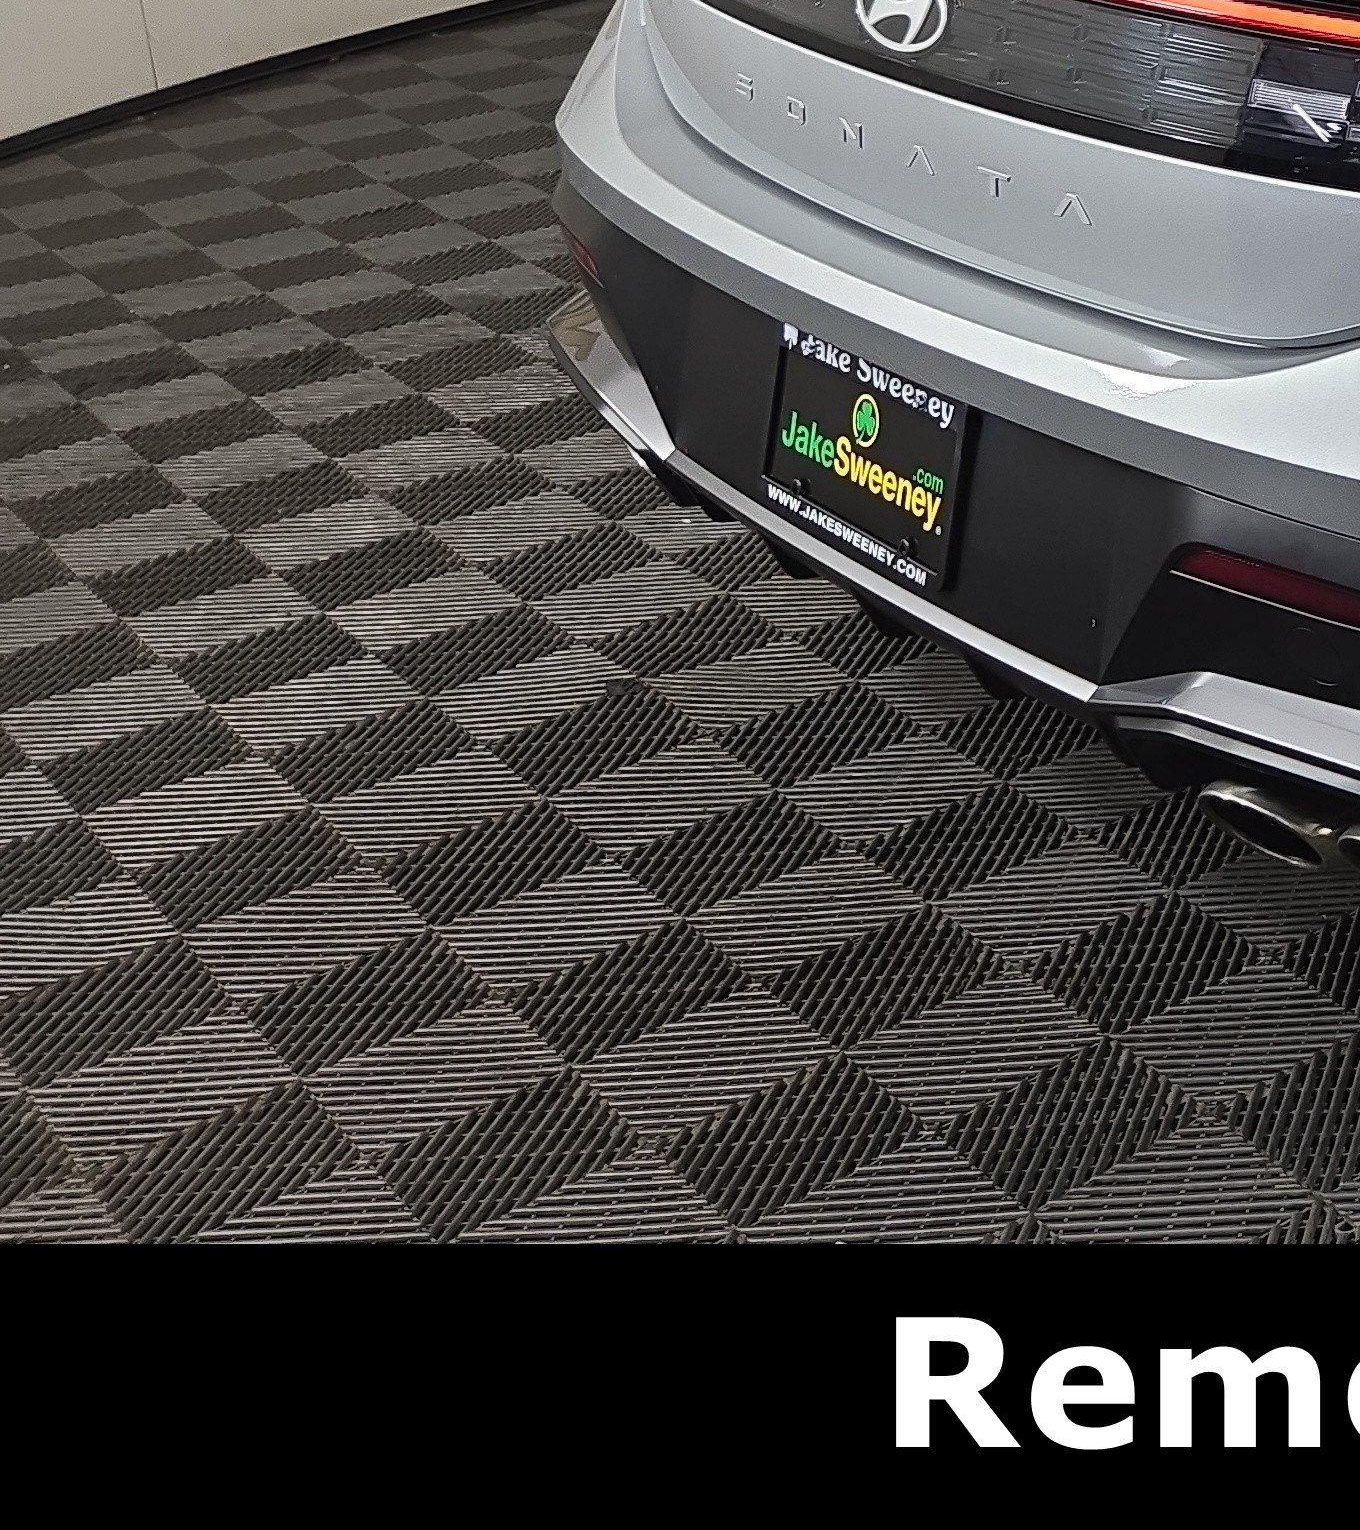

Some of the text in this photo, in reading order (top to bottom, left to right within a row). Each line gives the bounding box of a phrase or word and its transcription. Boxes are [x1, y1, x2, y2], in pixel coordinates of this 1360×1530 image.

[735, 73, 1093, 226] SONATA
[912, 468, 944, 495] .com
[767, 483, 927, 586] WWW.JAKESWEENEY.COM
